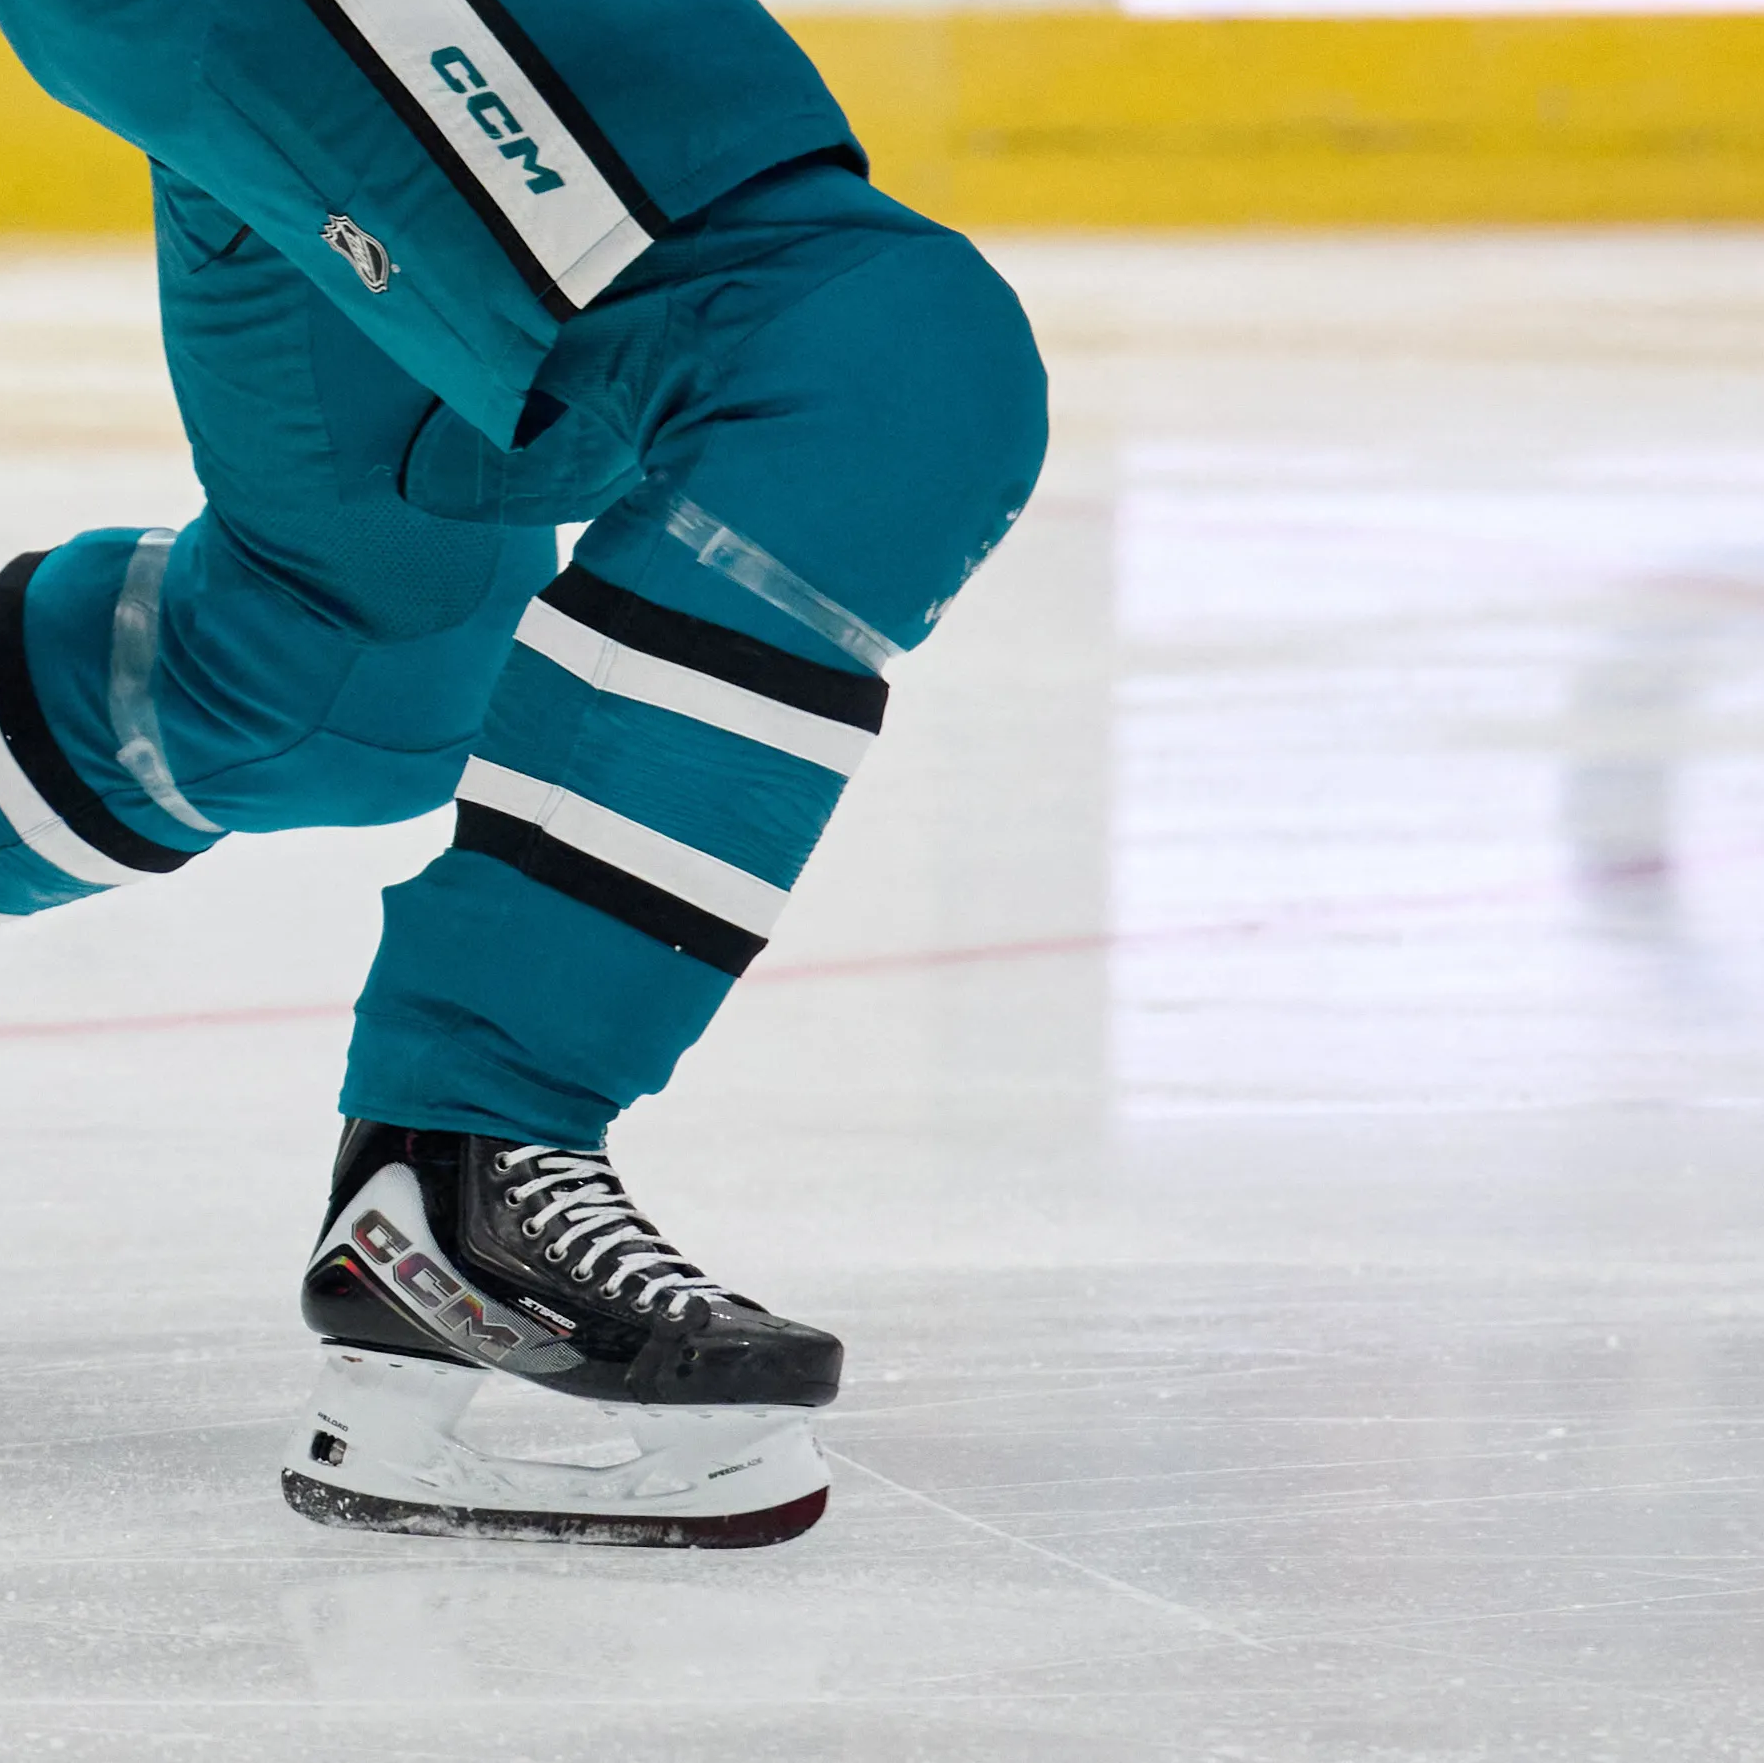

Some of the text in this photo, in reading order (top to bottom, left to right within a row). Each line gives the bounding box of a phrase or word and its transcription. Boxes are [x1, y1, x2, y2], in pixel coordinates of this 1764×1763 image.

[430, 45, 566, 195] CCM
[351, 1208, 525, 1363] CCM
[317, 1411, 349, 1433] RELOAD
